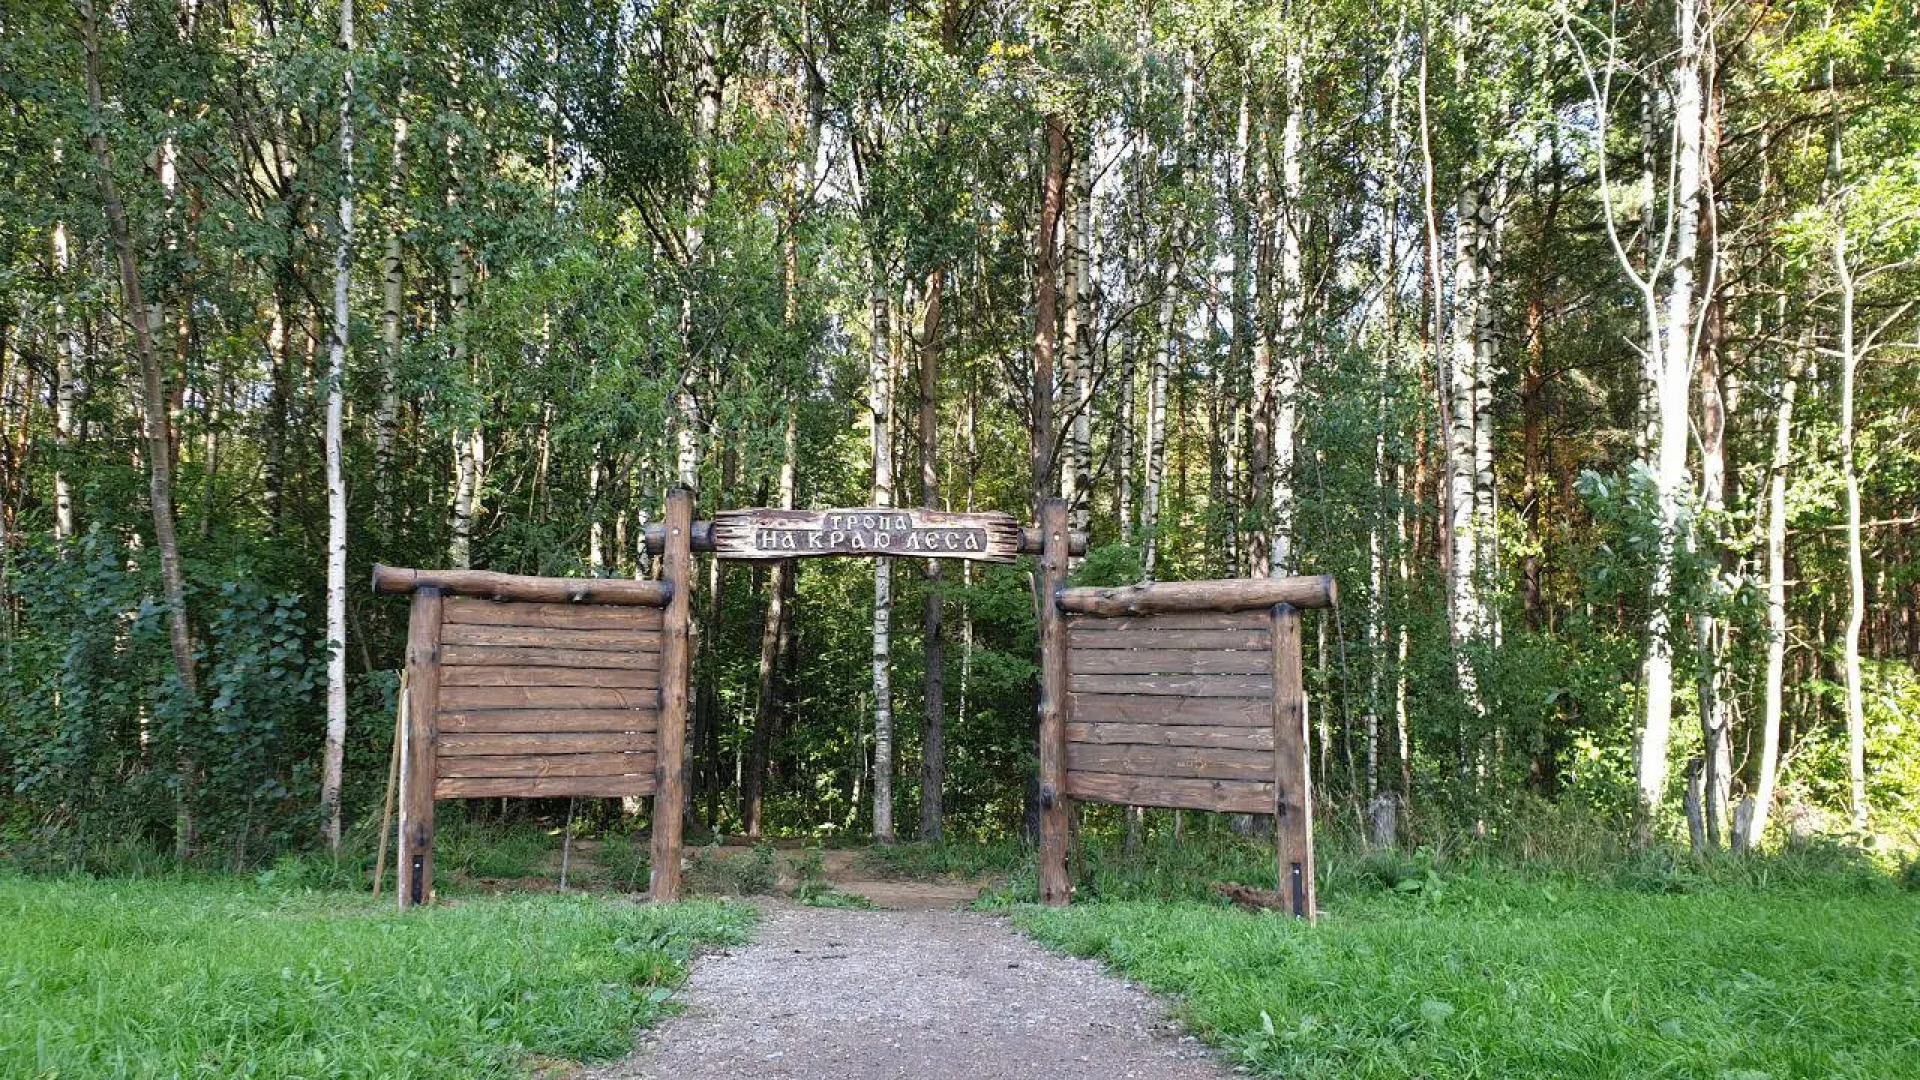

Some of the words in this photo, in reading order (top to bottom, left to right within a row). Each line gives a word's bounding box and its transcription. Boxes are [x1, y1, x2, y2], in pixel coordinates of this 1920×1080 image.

[831, 513, 908, 531] ТРОПА
[761, 531, 797, 549] НА
[808, 531, 891, 549] КРАЮ
[905, 531, 980, 550] ЛЕСА
